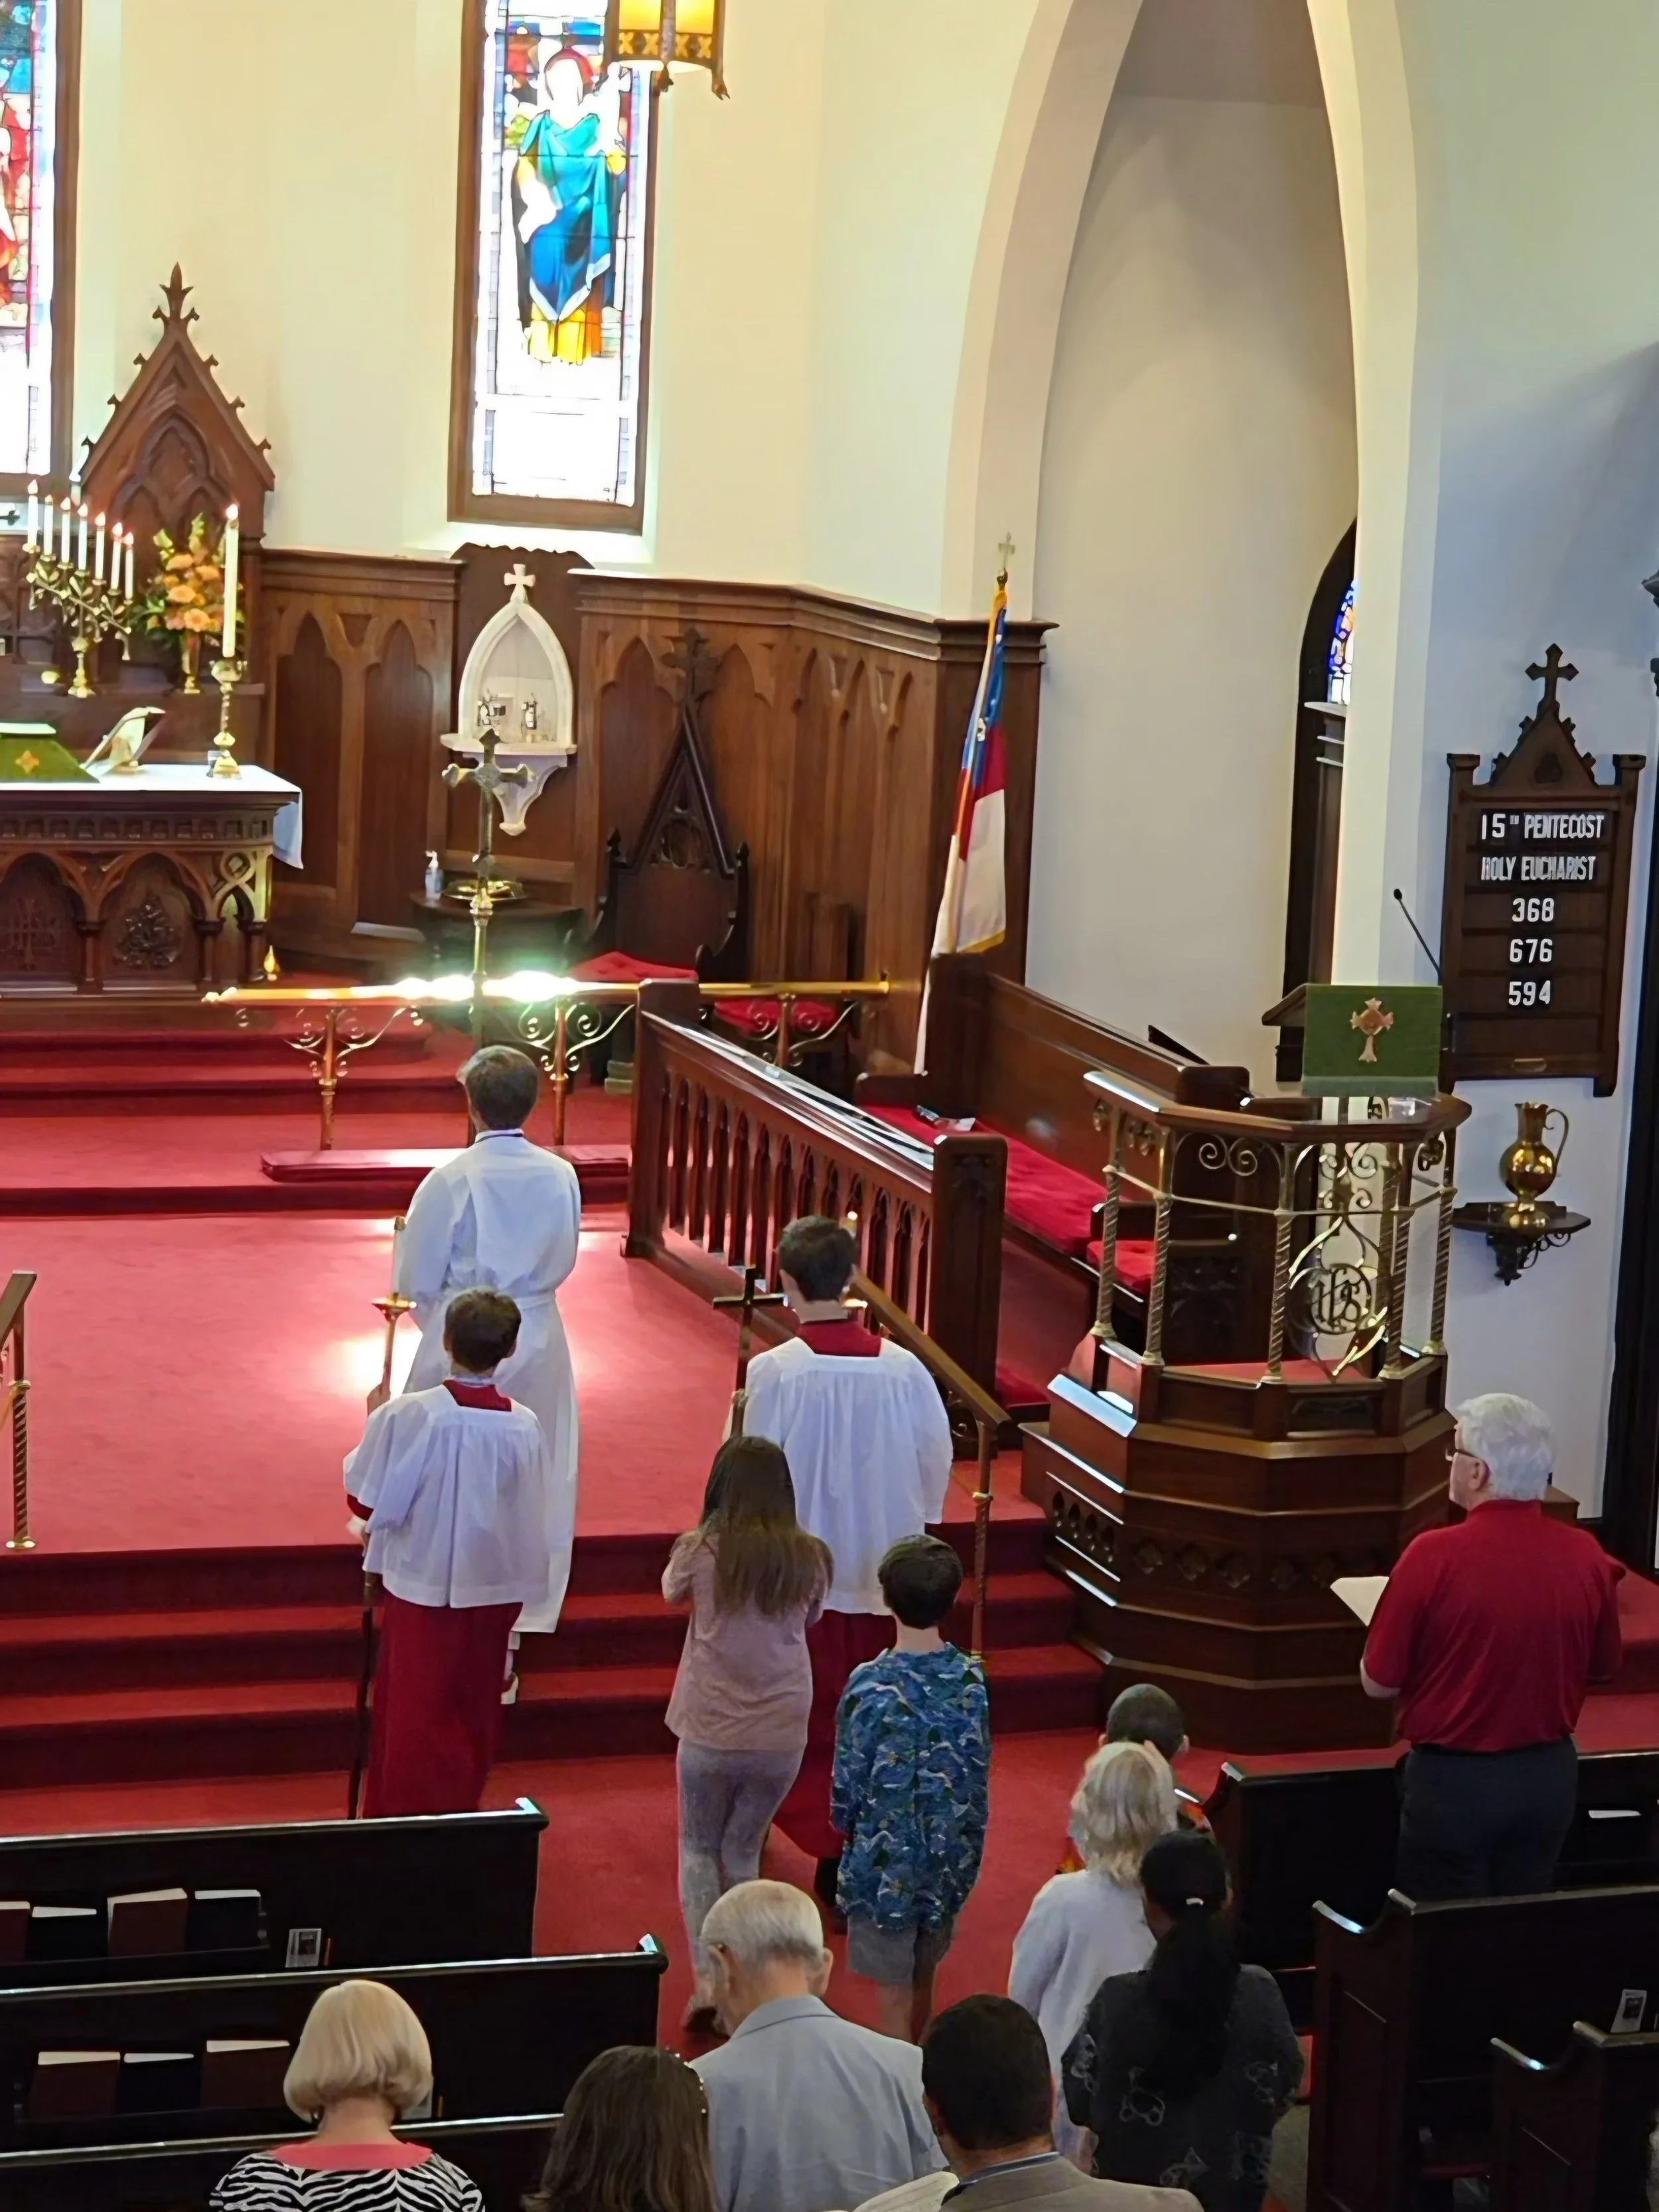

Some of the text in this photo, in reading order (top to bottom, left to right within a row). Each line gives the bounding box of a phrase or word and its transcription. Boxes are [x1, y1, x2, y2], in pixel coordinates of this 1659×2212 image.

[1524, 813, 1605, 839] PENTECOST
[1480, 855, 1597, 881] HOLY EUCHARIST
[1512, 897, 1555, 922] 368
[1509, 938, 1553, 964] 676
[1508, 980, 1551, 1006] 594
